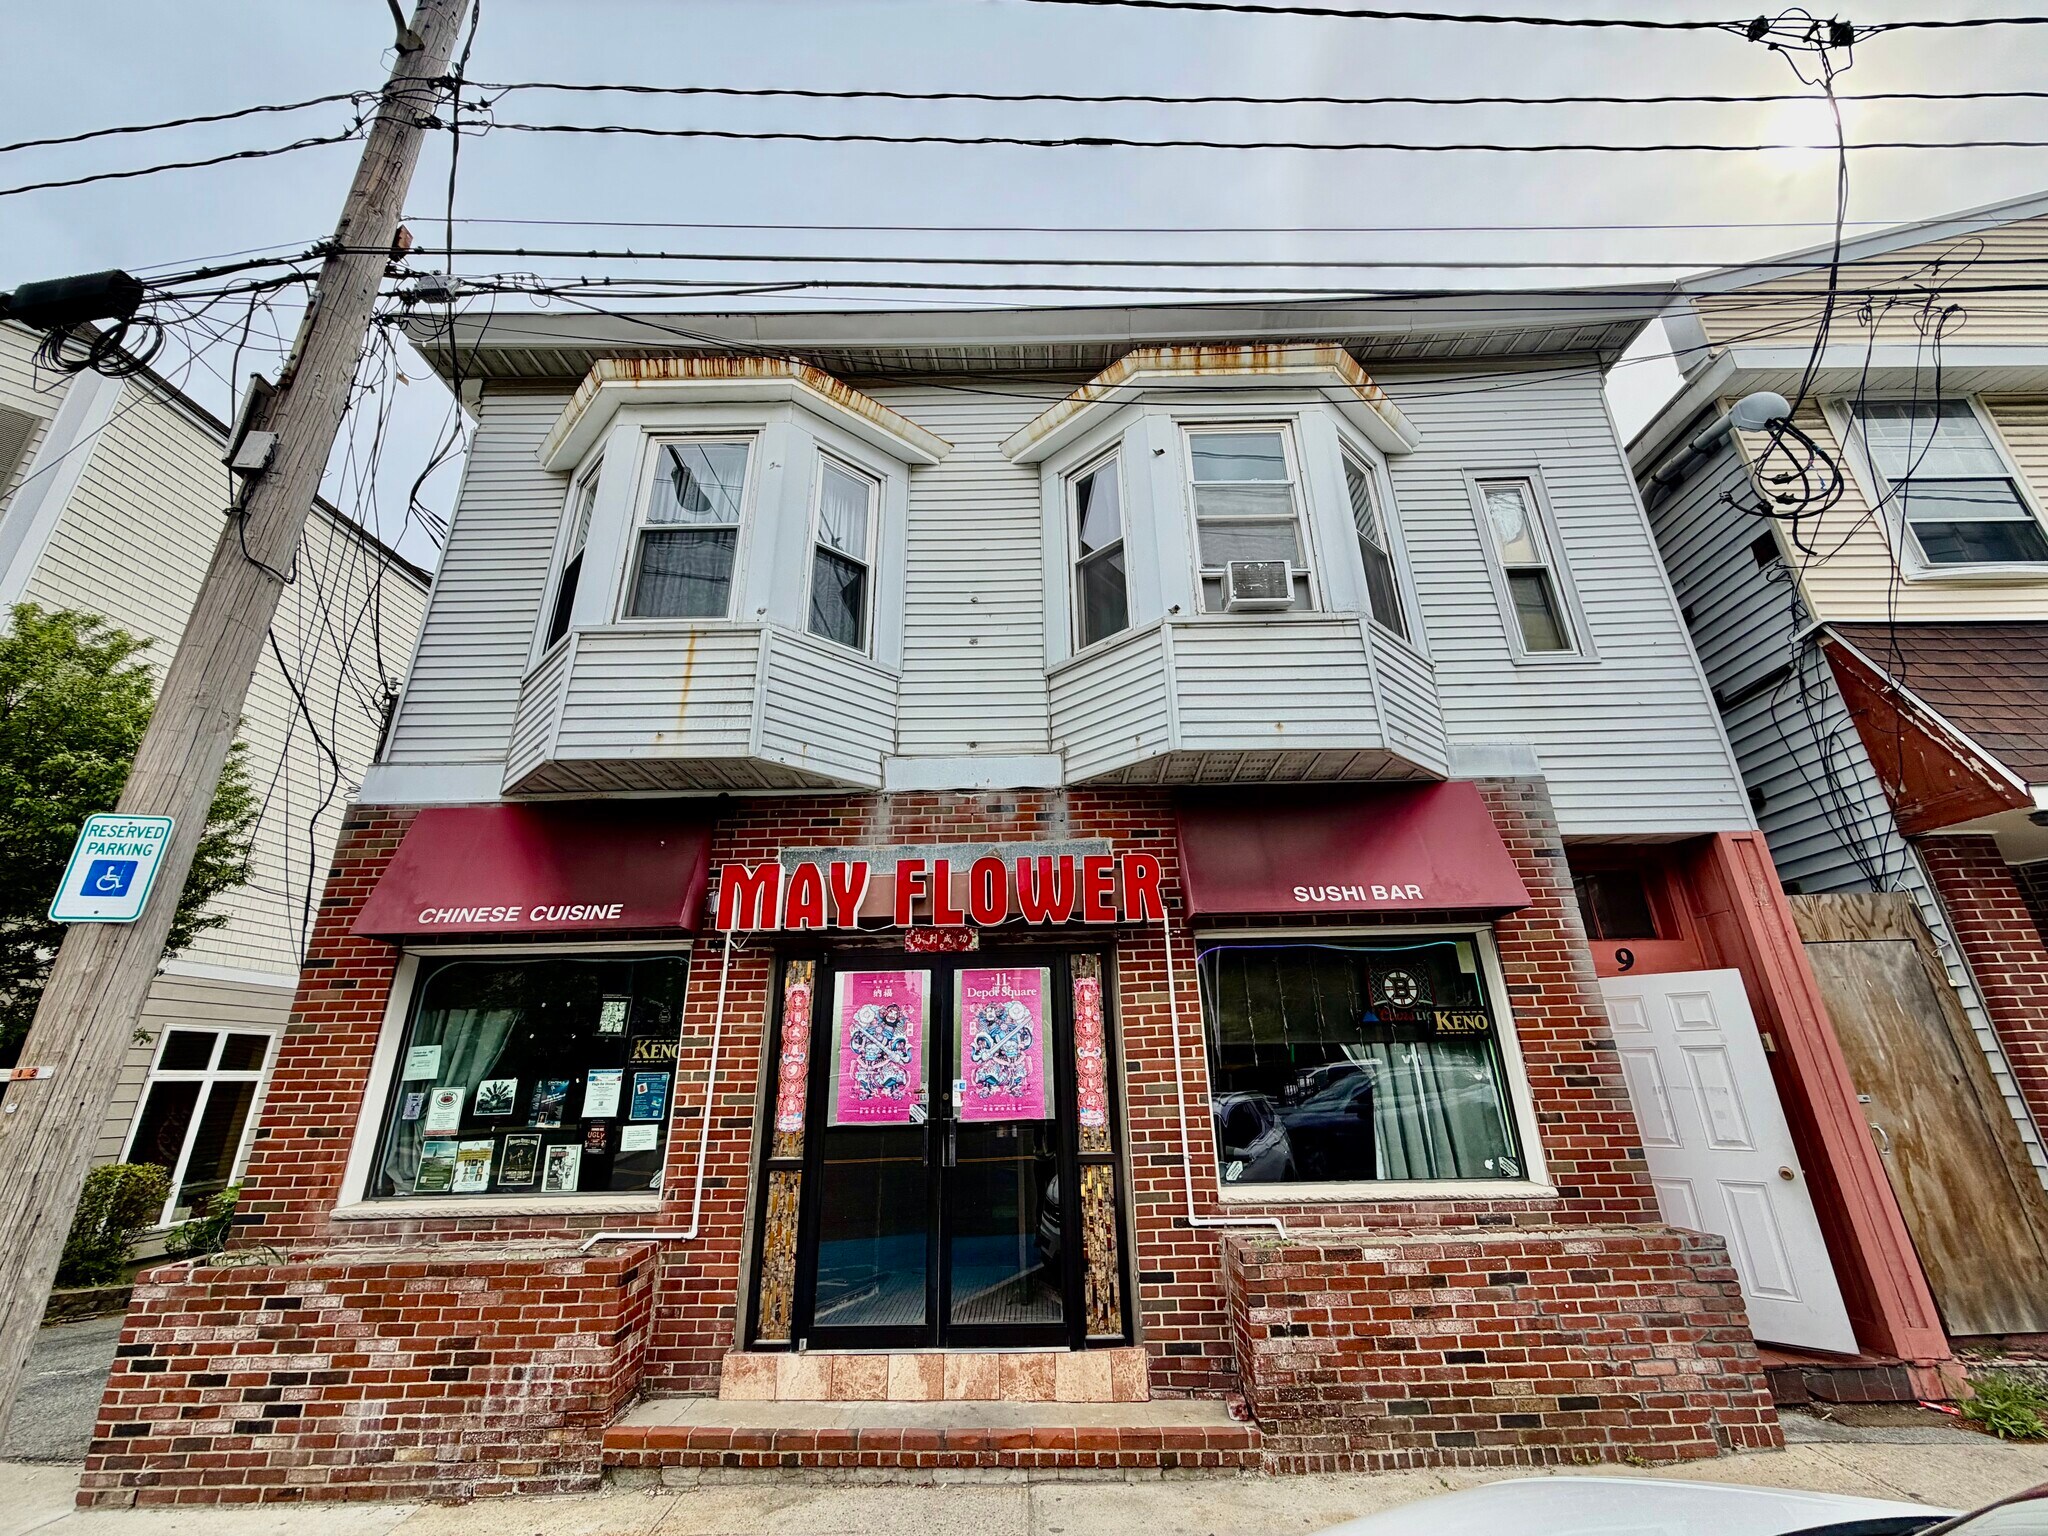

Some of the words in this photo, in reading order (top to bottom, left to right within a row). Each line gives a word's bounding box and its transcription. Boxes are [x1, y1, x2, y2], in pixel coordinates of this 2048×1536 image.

[87, 825, 165, 839] RESERVED
[85, 842, 154, 857] PARKING
[715, 860, 871, 932] MAY
[894, 853, 1166, 928] FLOWER
[1293, 885, 1367, 902] SUSHI
[1370, 884, 1424, 900] BAR
[418, 906, 522, 924] CHINESE
[529, 904, 624, 922] CUISINE
[912, 933, 968, 945] 马到成功
[1615, 947, 1635, 972] 9
[995, 973, 1008, 986] 11
[967, 986, 999, 999] Depot
[1001, 986, 1037, 999] Square
[1433, 1011, 1488, 1030] KENO
